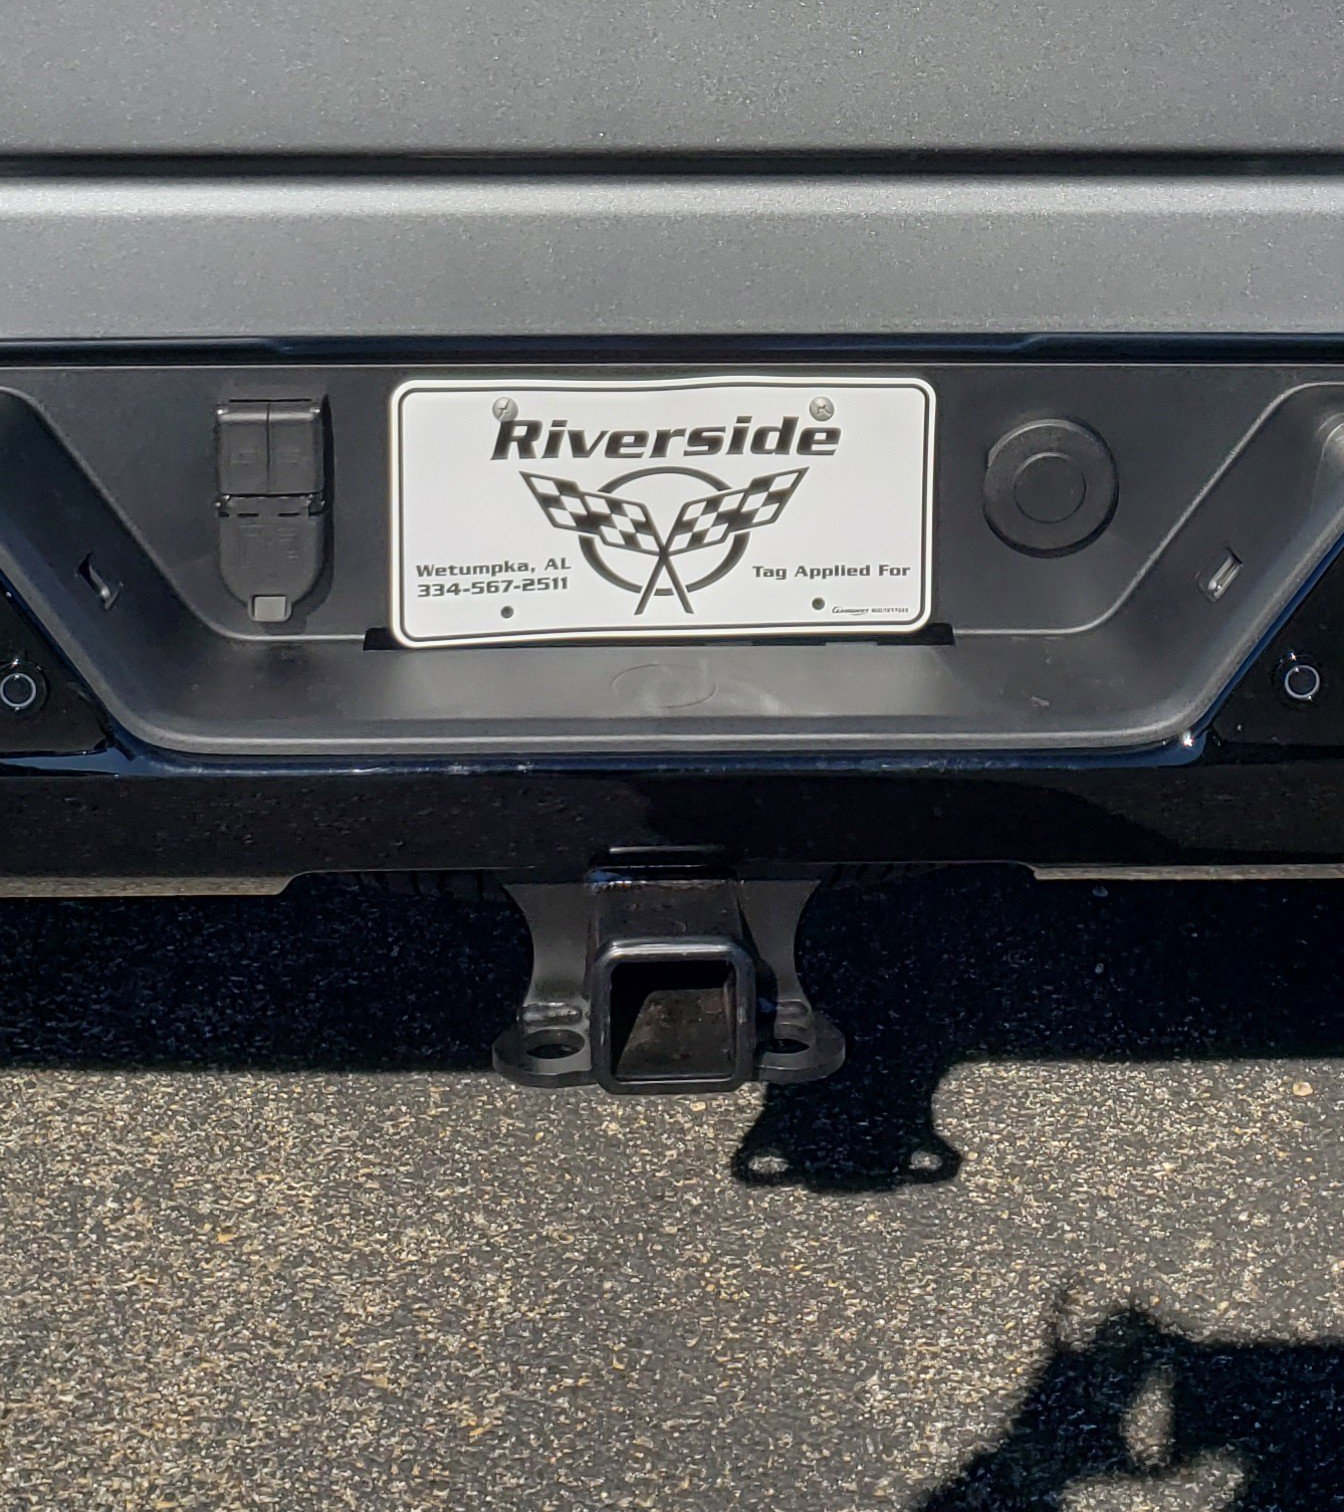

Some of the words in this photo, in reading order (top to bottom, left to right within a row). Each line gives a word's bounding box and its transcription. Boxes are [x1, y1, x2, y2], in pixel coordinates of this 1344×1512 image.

[490, 416, 842, 461] Riverside
[416, 560, 536, 578] Wetumpka,
[544, 557, 572, 571] AL
[752, 565, 787, 581] Tag
[794, 564, 871, 580] Applied
[878, 563, 911, 577] For
[417, 576, 569, 598] 334-567-2511
